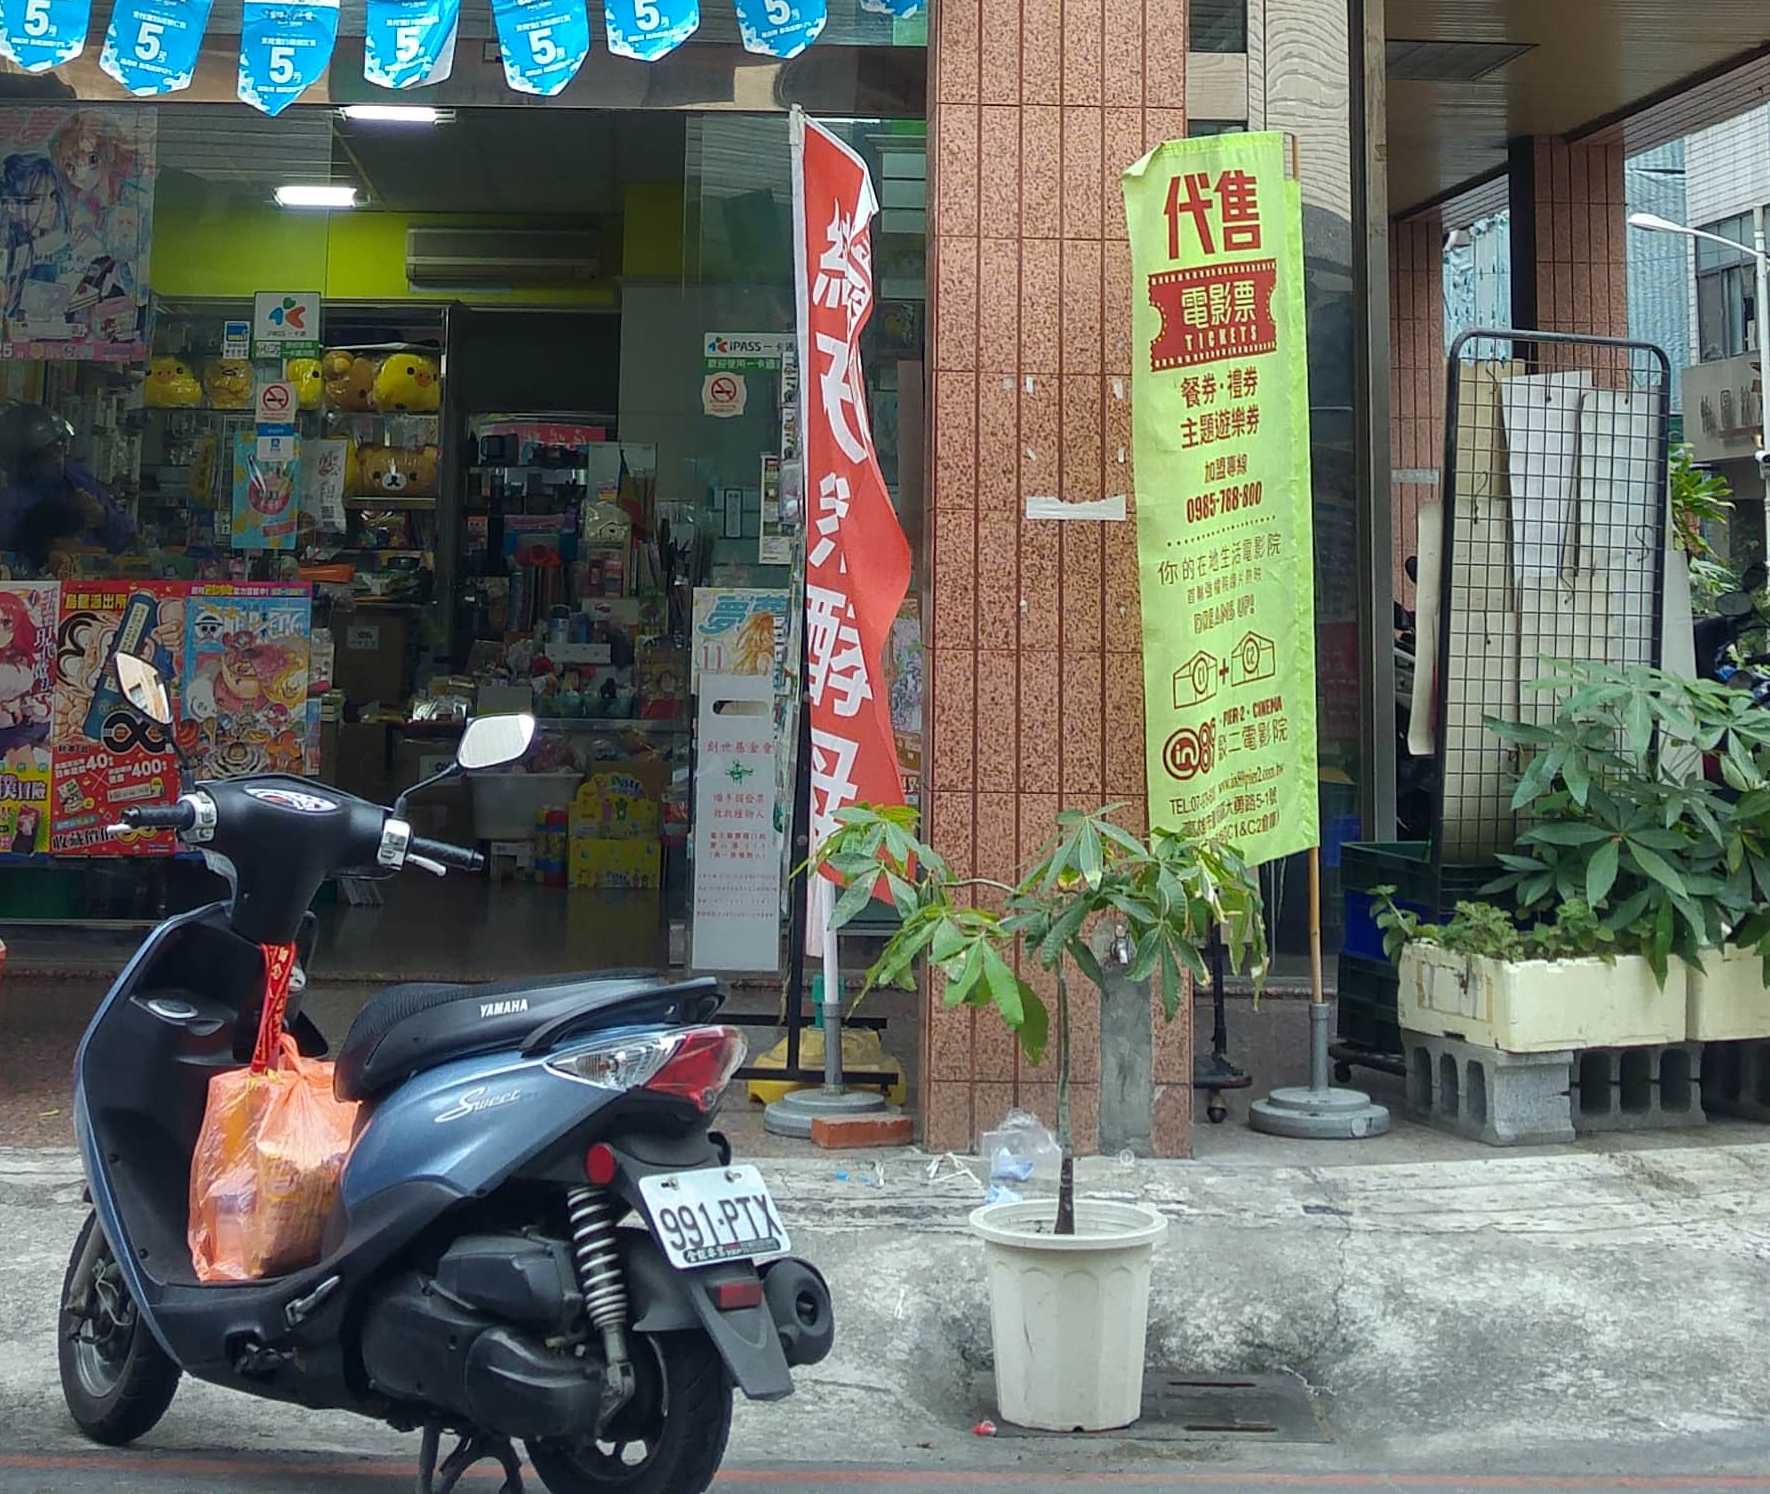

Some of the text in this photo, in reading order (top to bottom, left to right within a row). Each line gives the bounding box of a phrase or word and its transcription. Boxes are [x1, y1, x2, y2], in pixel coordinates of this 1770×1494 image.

[1164, 171, 1261, 260] 代售
[1181, 282, 1256, 329] 電影票
[1185, 326, 1258, 352] TICKETS
[1180, 406, 1261, 449] 主題遊樂券
[1204, 455, 1248, 483] 加盟專線
[707, 740, 775, 755] 創世基金會
[480, 998, 528, 1018] YAMAHA
[659, 1193, 784, 1250] 991-PTX
